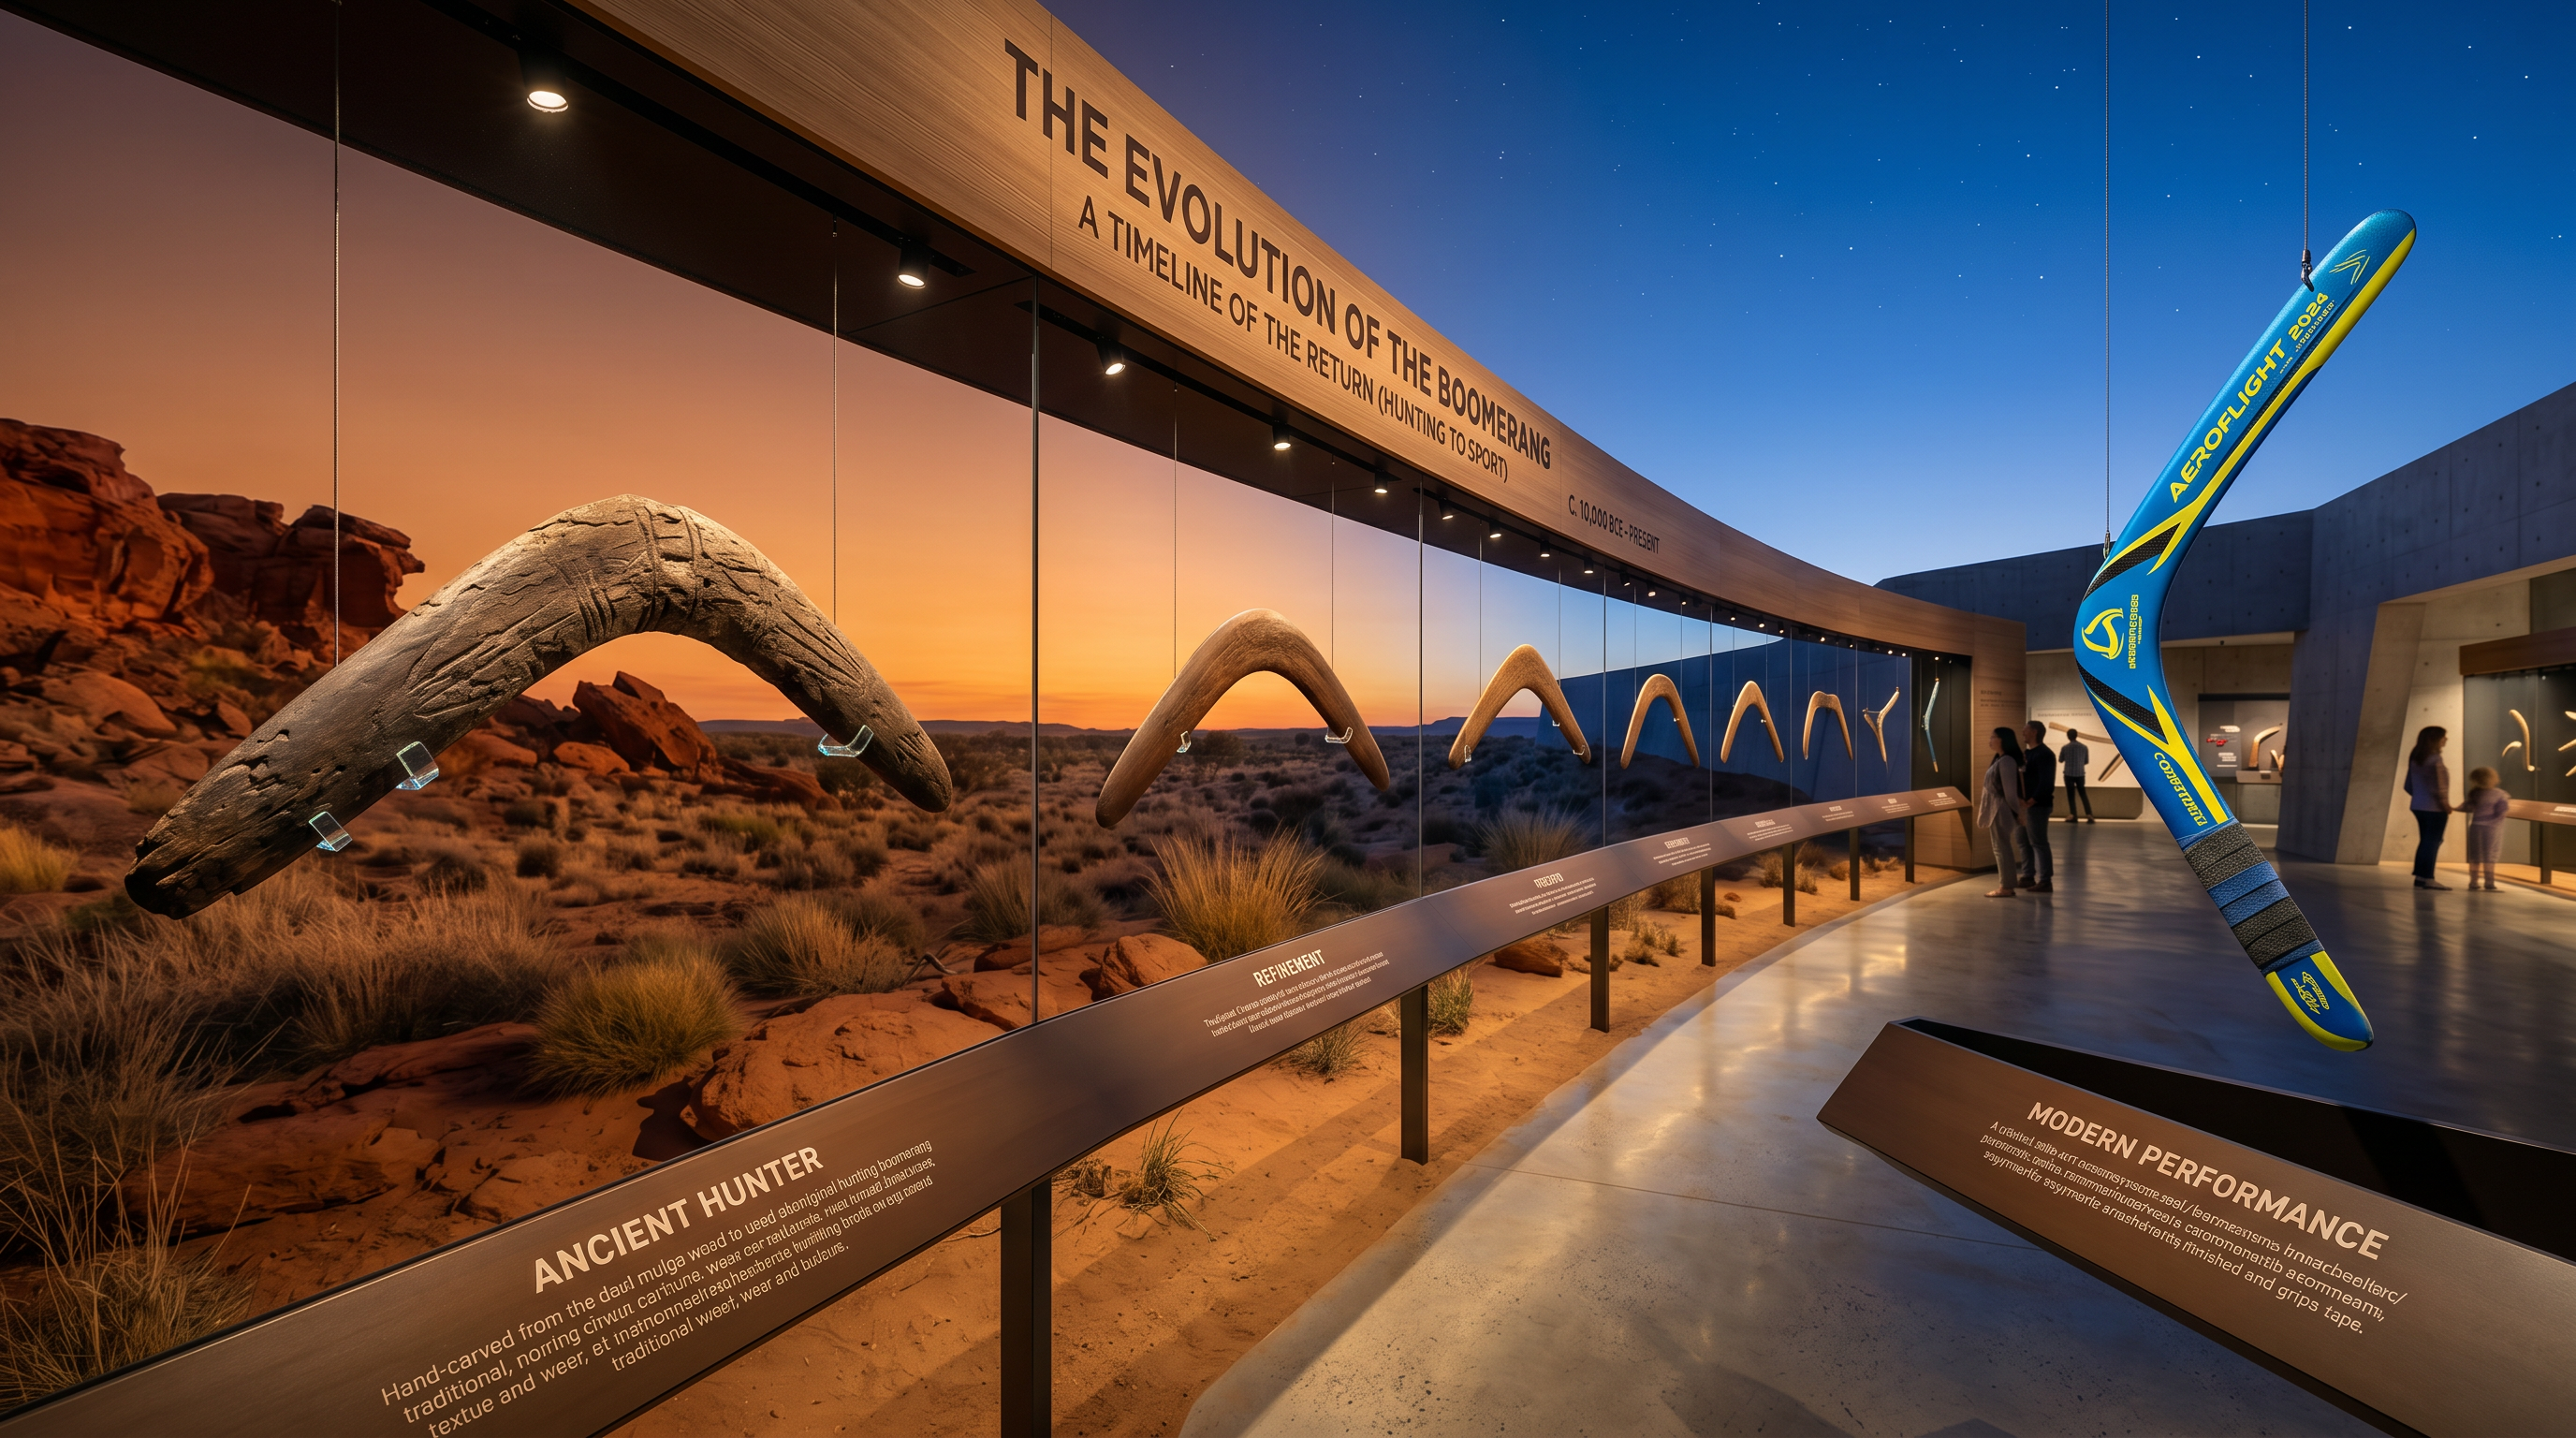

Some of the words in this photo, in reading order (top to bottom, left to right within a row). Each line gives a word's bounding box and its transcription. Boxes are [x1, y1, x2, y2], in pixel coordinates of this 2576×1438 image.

[1004, 37, 1108, 180] THE
[1125, 133, 1336, 335] EVOLUTION
[1345, 303, 1380, 359] OF
[1387, 330, 1431, 397] THE
[1438, 365, 1551, 469] BOOMERANG
[1078, 195, 1099, 240] A
[1107, 210, 1222, 315] TIMELINE
[1229, 292, 1258, 332] OF
[1264, 312, 1301, 362] THE
[1308, 339, 1373, 404] RETURN
[1378, 385, 1445, 445] (HUNTING
[1449, 426, 1466, 456] TO
[1468, 439, 1508, 483] SPORT)
[2170, 339, 2285, 503] AEROFLIGHT
[2289, 292, 2329, 341] 2024
[1580, 500, 1608, 530] 10,000
[1609, 514, 1623, 538] BCE
[1629, 524, 1660, 554] PRESENT
[1252, 949, 1325, 987] REFINEMENT
[534, 1198, 691, 1294] ANCIENT
[696, 1146, 824, 1218] HUNTER
[2027, 1102, 2140, 1159] MODERN
[2140, 1145, 2389, 1260] PERFORMANCE
[382, 1329, 515, 1405] Hand-carved
[519, 1313, 563, 1340] from
[566, 1298, 595, 1317] the
[837, 1166, 879, 1190] hunting
[612, 1317, 694, 1371] traditional
[739, 1279, 771, 1302] wear
[776, 1262, 799, 1284] and
[2245, 1271, 2276, 1290] and
[2276, 1287, 2319, 1312] grips
[2324, 1306, 2363, 1334] tape.
[403, 1359, 512, 1423] traditional,
[499, 1373, 535, 1404] and
